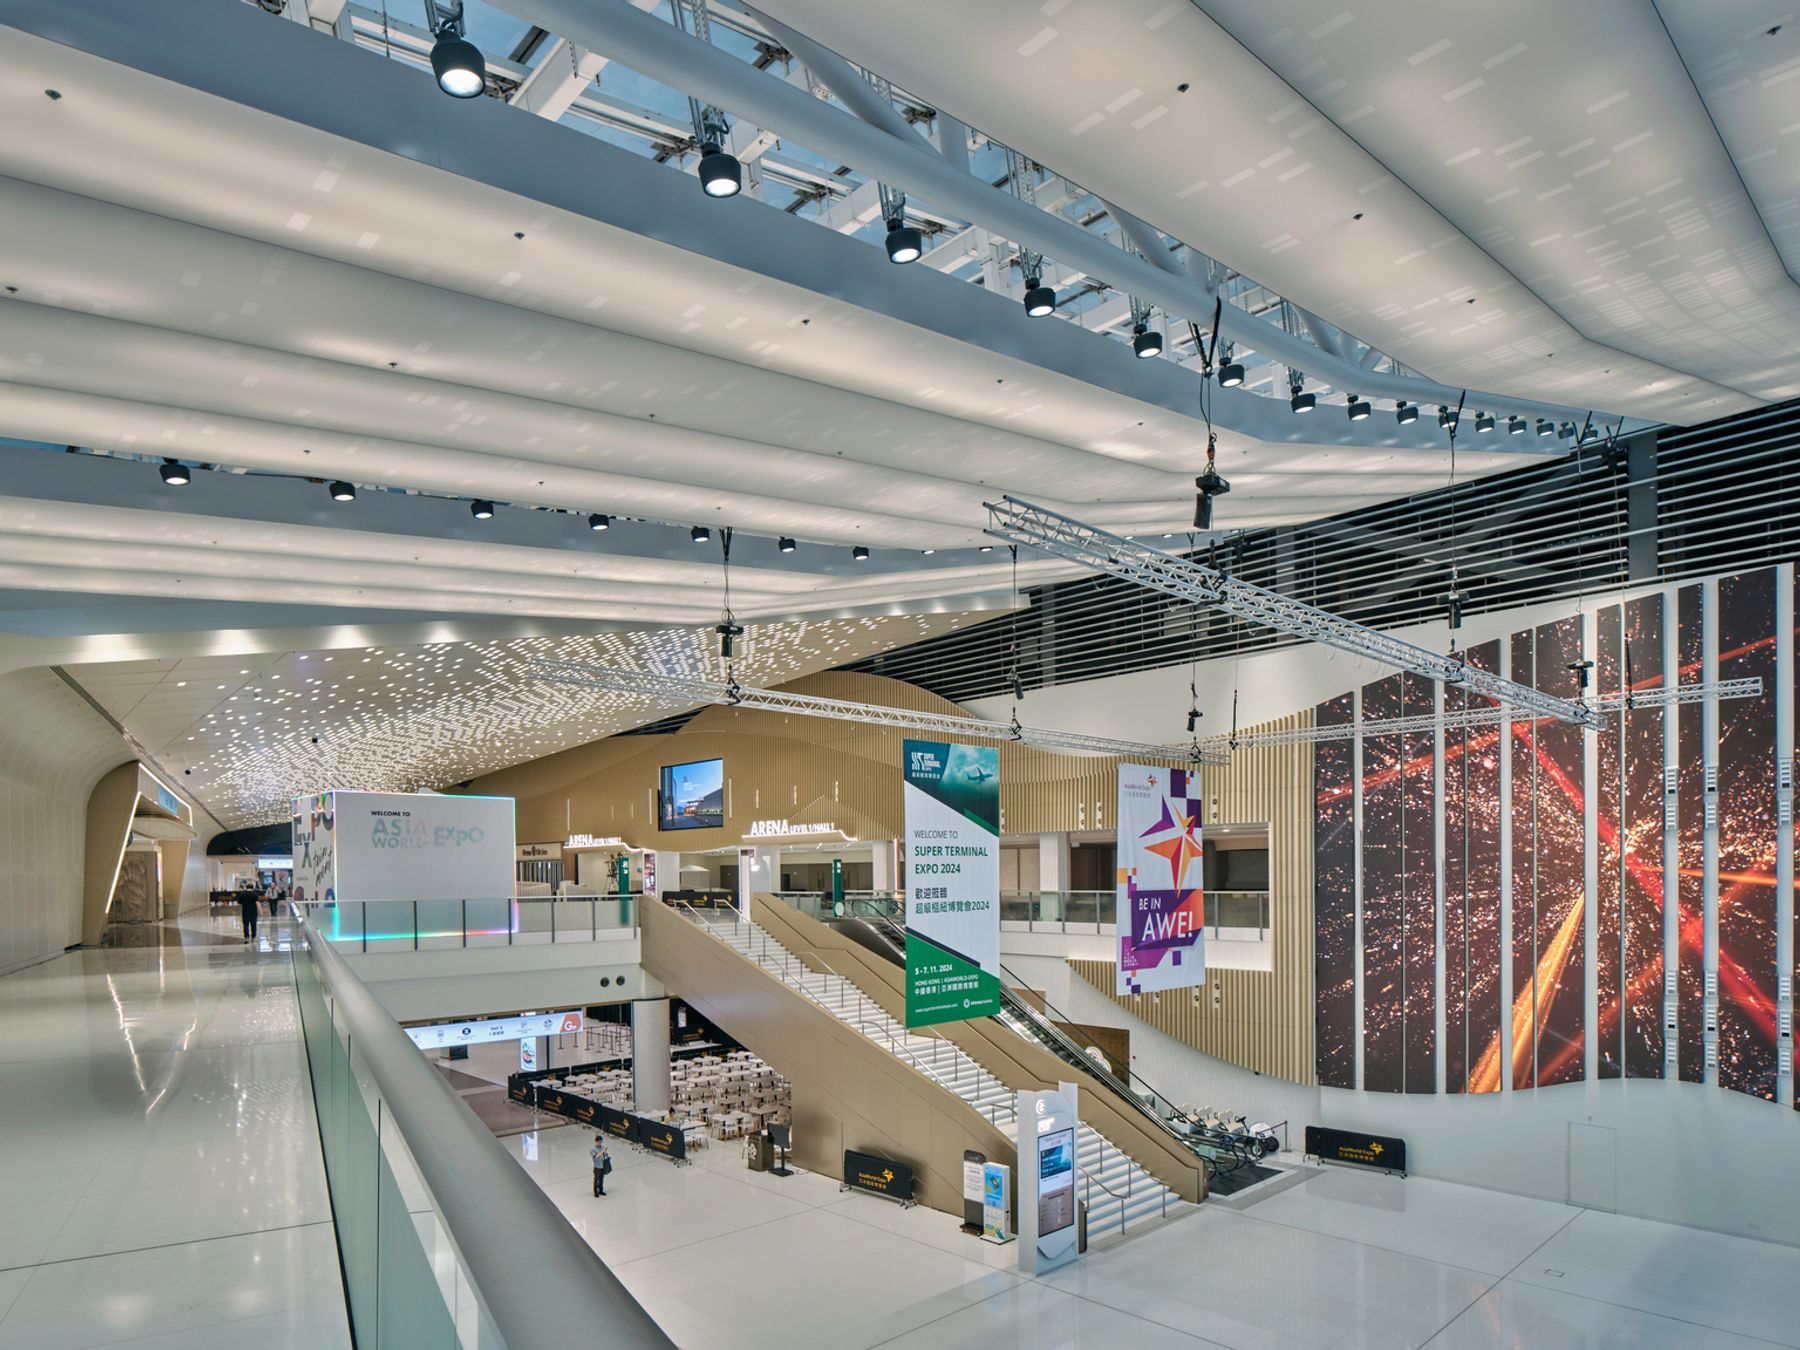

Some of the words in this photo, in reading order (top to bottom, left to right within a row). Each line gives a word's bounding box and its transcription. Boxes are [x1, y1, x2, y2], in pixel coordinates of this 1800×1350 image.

[371, 817, 429, 838] ASIA
[751, 819, 789, 836] ARENA
[569, 833, 593, 847] ARENA
[914, 830, 947, 839] WELCOME
[949, 831, 958, 839] TO
[914, 846, 943, 856] SUPER
[945, 846, 988, 857] TERMINAL
[915, 863, 939, 874] EXPO
[940, 864, 961, 874] 2024
[1139, 898, 1148, 910] BE
[1151, 898, 1161, 910] IN
[1142, 911, 1193, 941] AWE!
